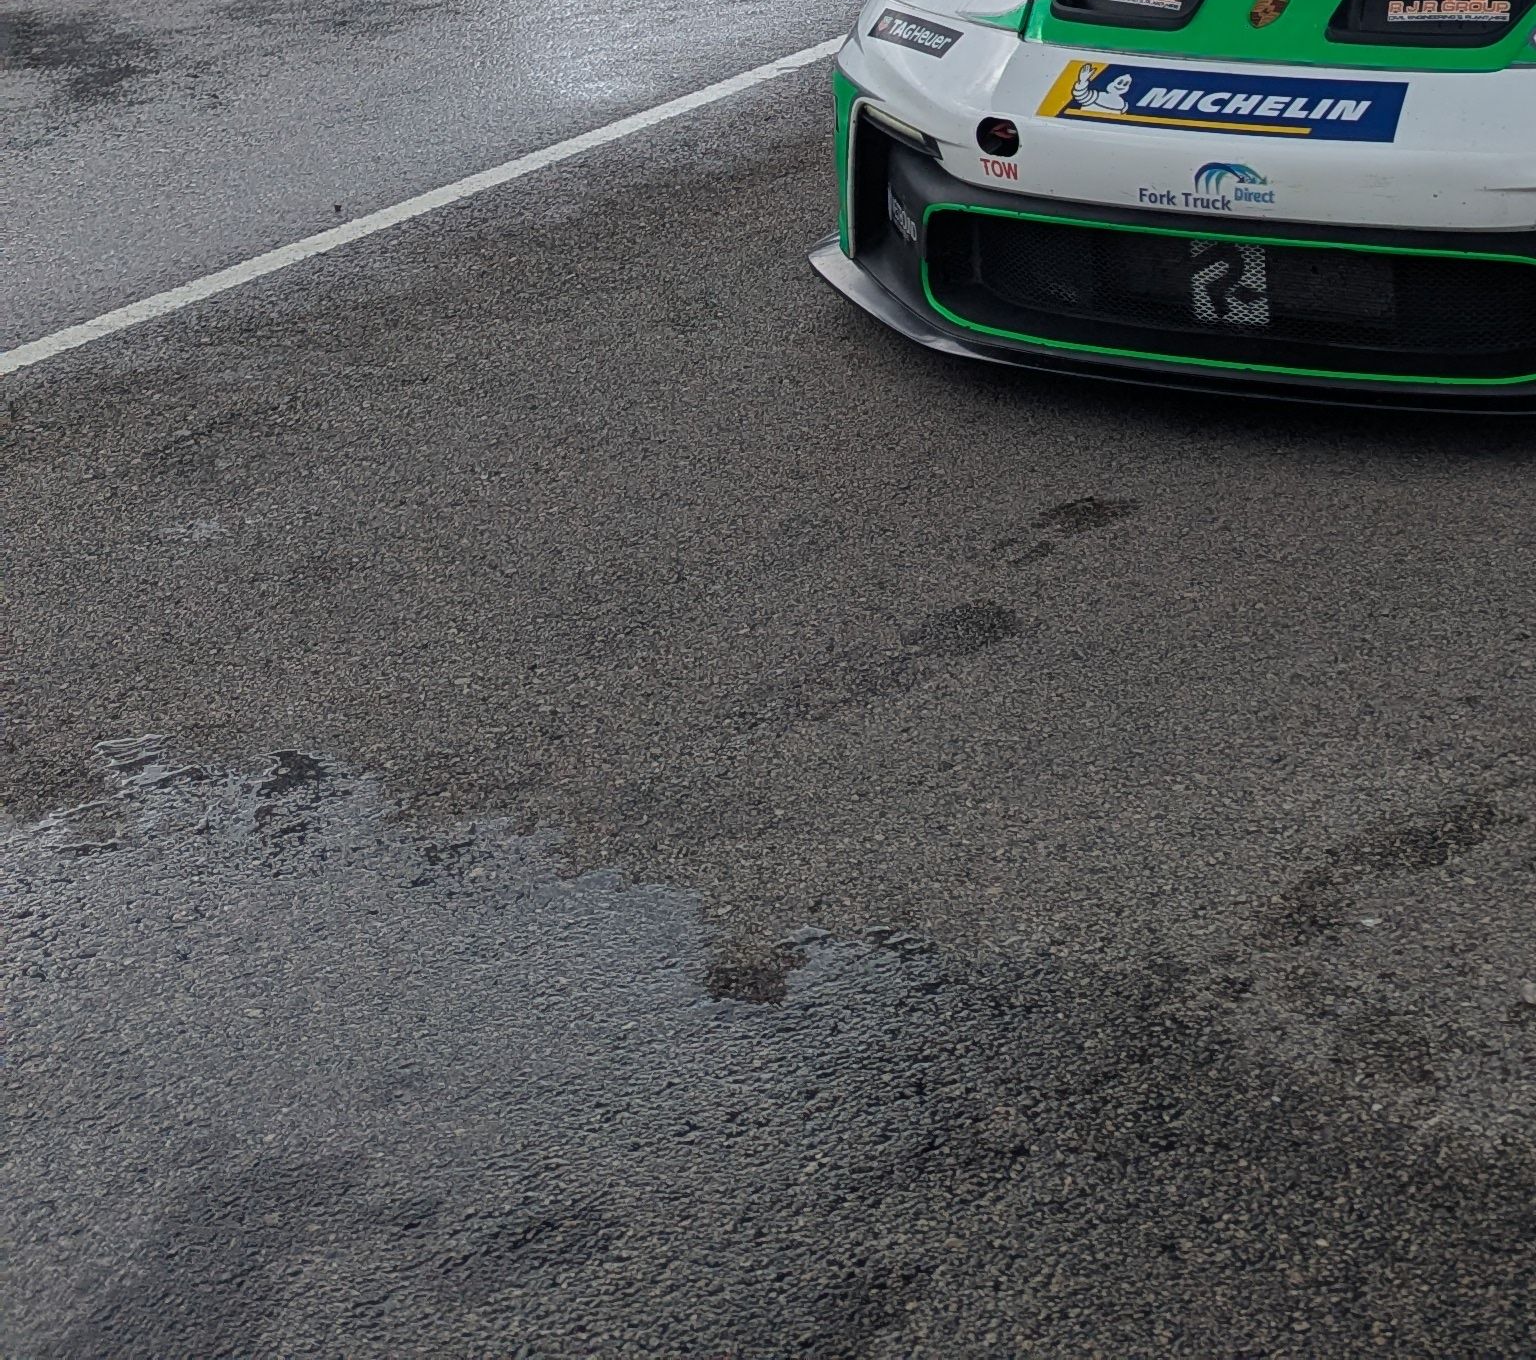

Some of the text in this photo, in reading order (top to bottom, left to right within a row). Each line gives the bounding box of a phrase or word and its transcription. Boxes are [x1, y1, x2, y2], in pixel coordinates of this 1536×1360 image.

[1441, 0, 1511, 14] GROUP
[1135, 86, 1373, 122] MICHELIN
[979, 158, 1019, 180] TOW
[1138, 186, 1276, 212] Fork Truck Direct
